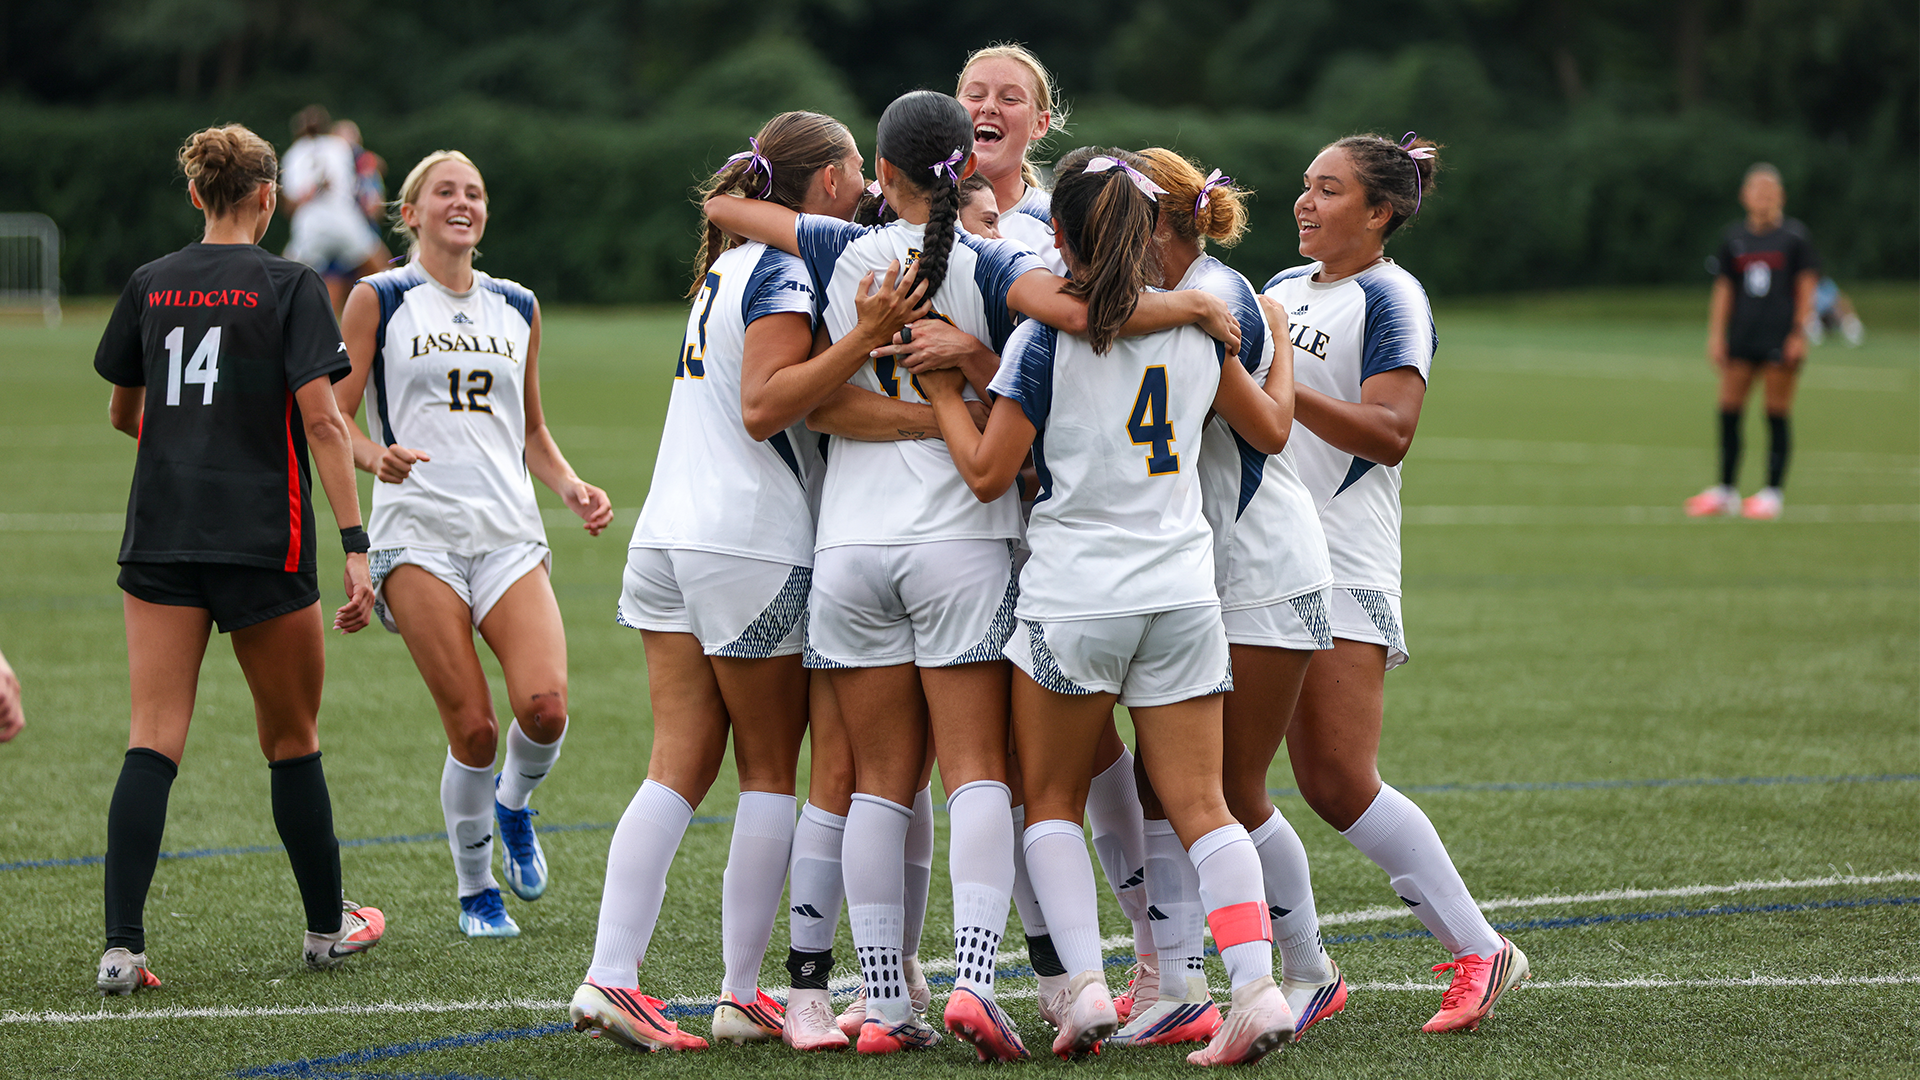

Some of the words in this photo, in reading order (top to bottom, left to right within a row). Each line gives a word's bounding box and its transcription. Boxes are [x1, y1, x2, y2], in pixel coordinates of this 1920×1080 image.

[148, 289, 259, 308] WILDCATS
[164, 325, 222, 406] 14
[447, 368, 494, 415] 12
[1126, 365, 1180, 477] 4
